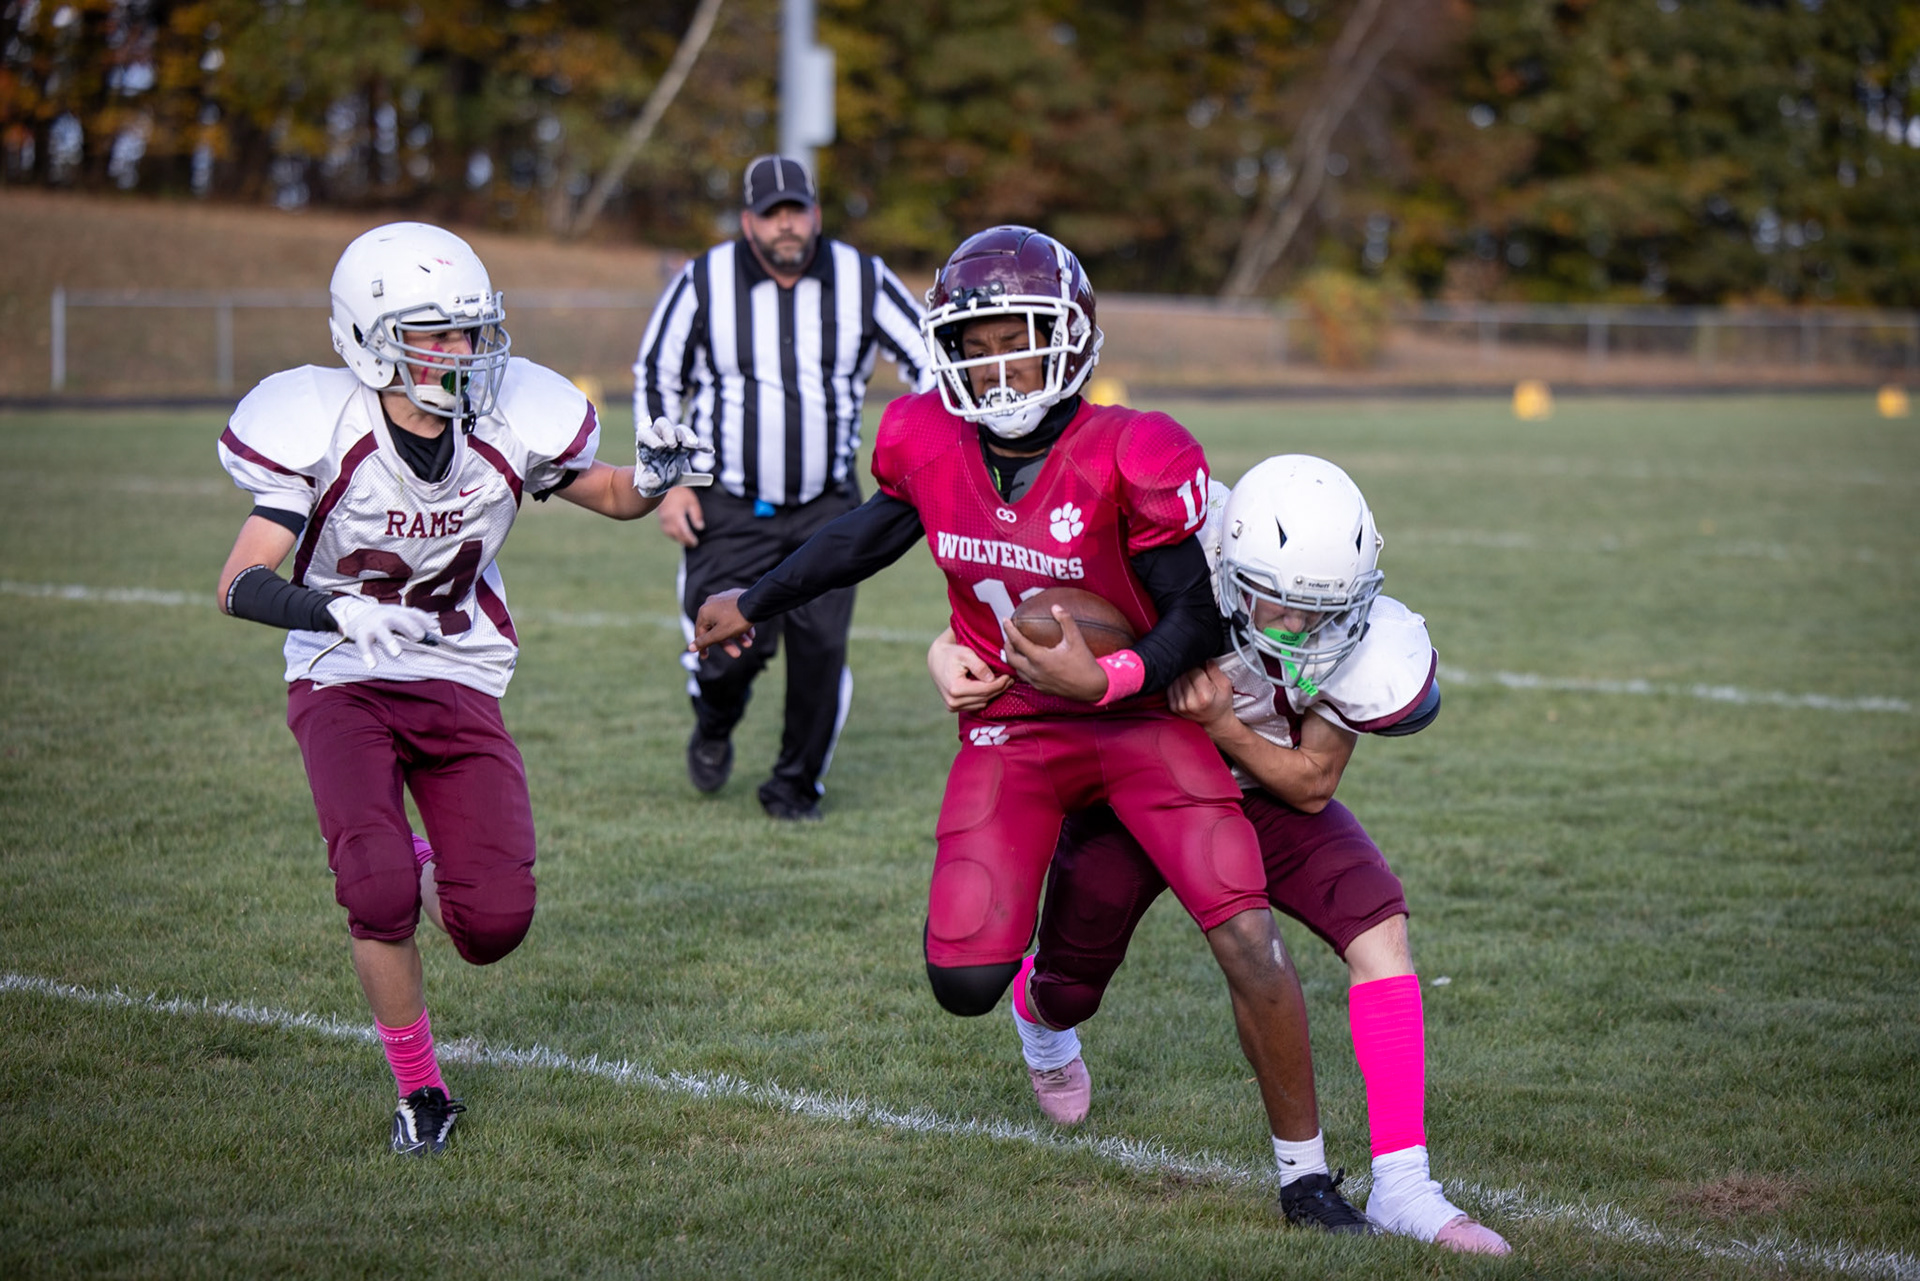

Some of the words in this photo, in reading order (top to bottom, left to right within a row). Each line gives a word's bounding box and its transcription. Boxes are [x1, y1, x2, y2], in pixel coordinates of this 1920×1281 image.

[385, 509, 464, 538] RAMS
[937, 530, 1085, 580] WOLVERINES
[972, 577, 1046, 663] 1
